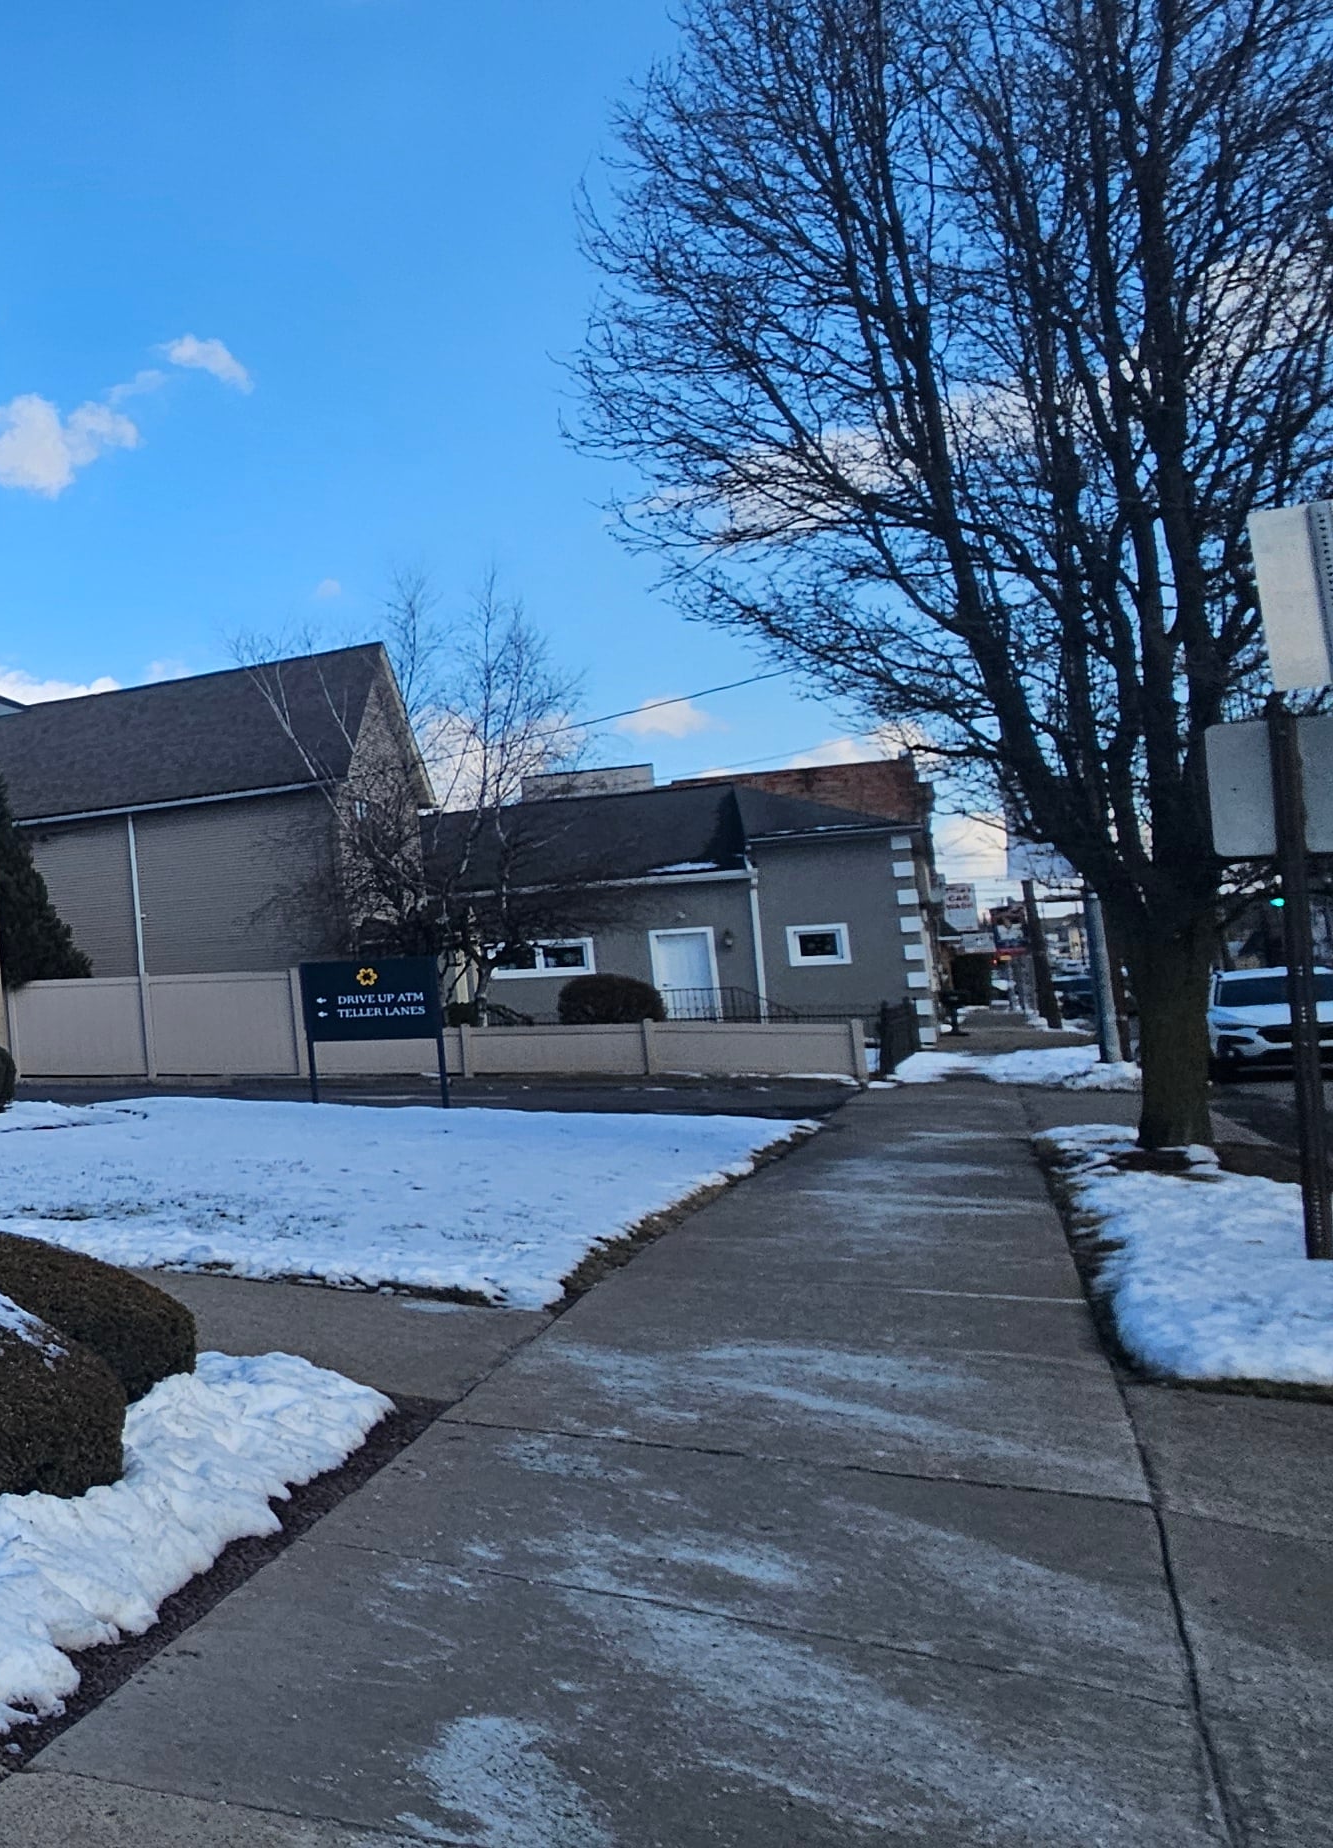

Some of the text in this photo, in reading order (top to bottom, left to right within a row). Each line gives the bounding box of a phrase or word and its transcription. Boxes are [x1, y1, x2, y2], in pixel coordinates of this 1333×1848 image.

[337, 991, 424, 1005] DRIVE UP ATM
[337, 1005, 426, 1018] TELLER LANES
